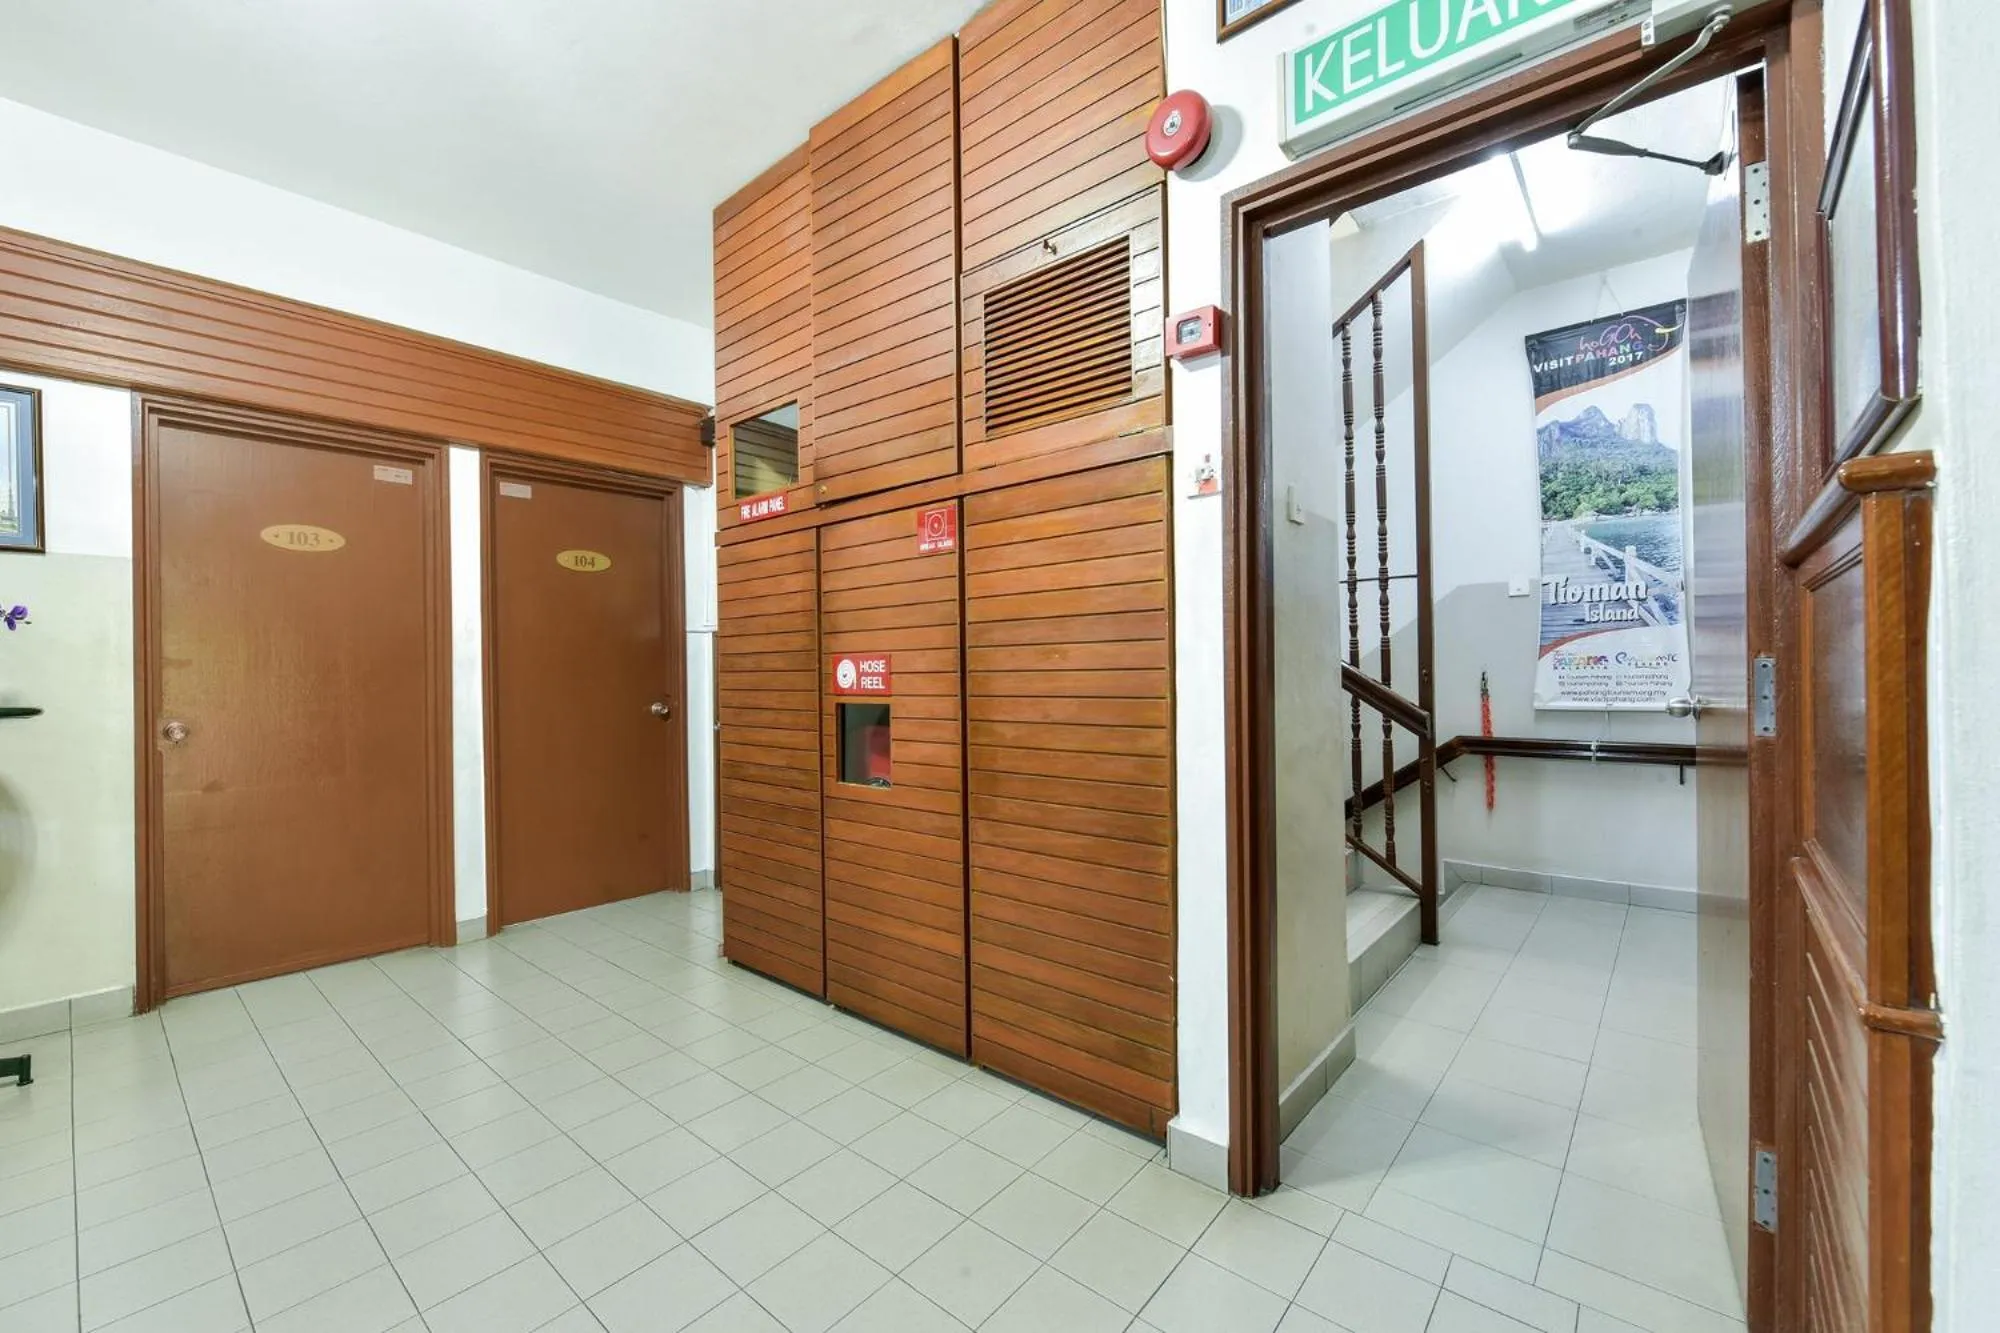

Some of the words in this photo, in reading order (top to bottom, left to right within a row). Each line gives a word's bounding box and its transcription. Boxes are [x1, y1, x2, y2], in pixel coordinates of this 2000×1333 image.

[1303, 0, 1547, 112] KELUA
[1608, 351, 1643, 366] 2017
[287, 531, 320, 547] 103
[574, 555, 596, 569] 104
[1542, 576, 1648, 605] Tioman
[1584, 603, 1641, 622] Island
[859, 660, 886, 672] HOSE
[860, 676, 886, 689] REEL
